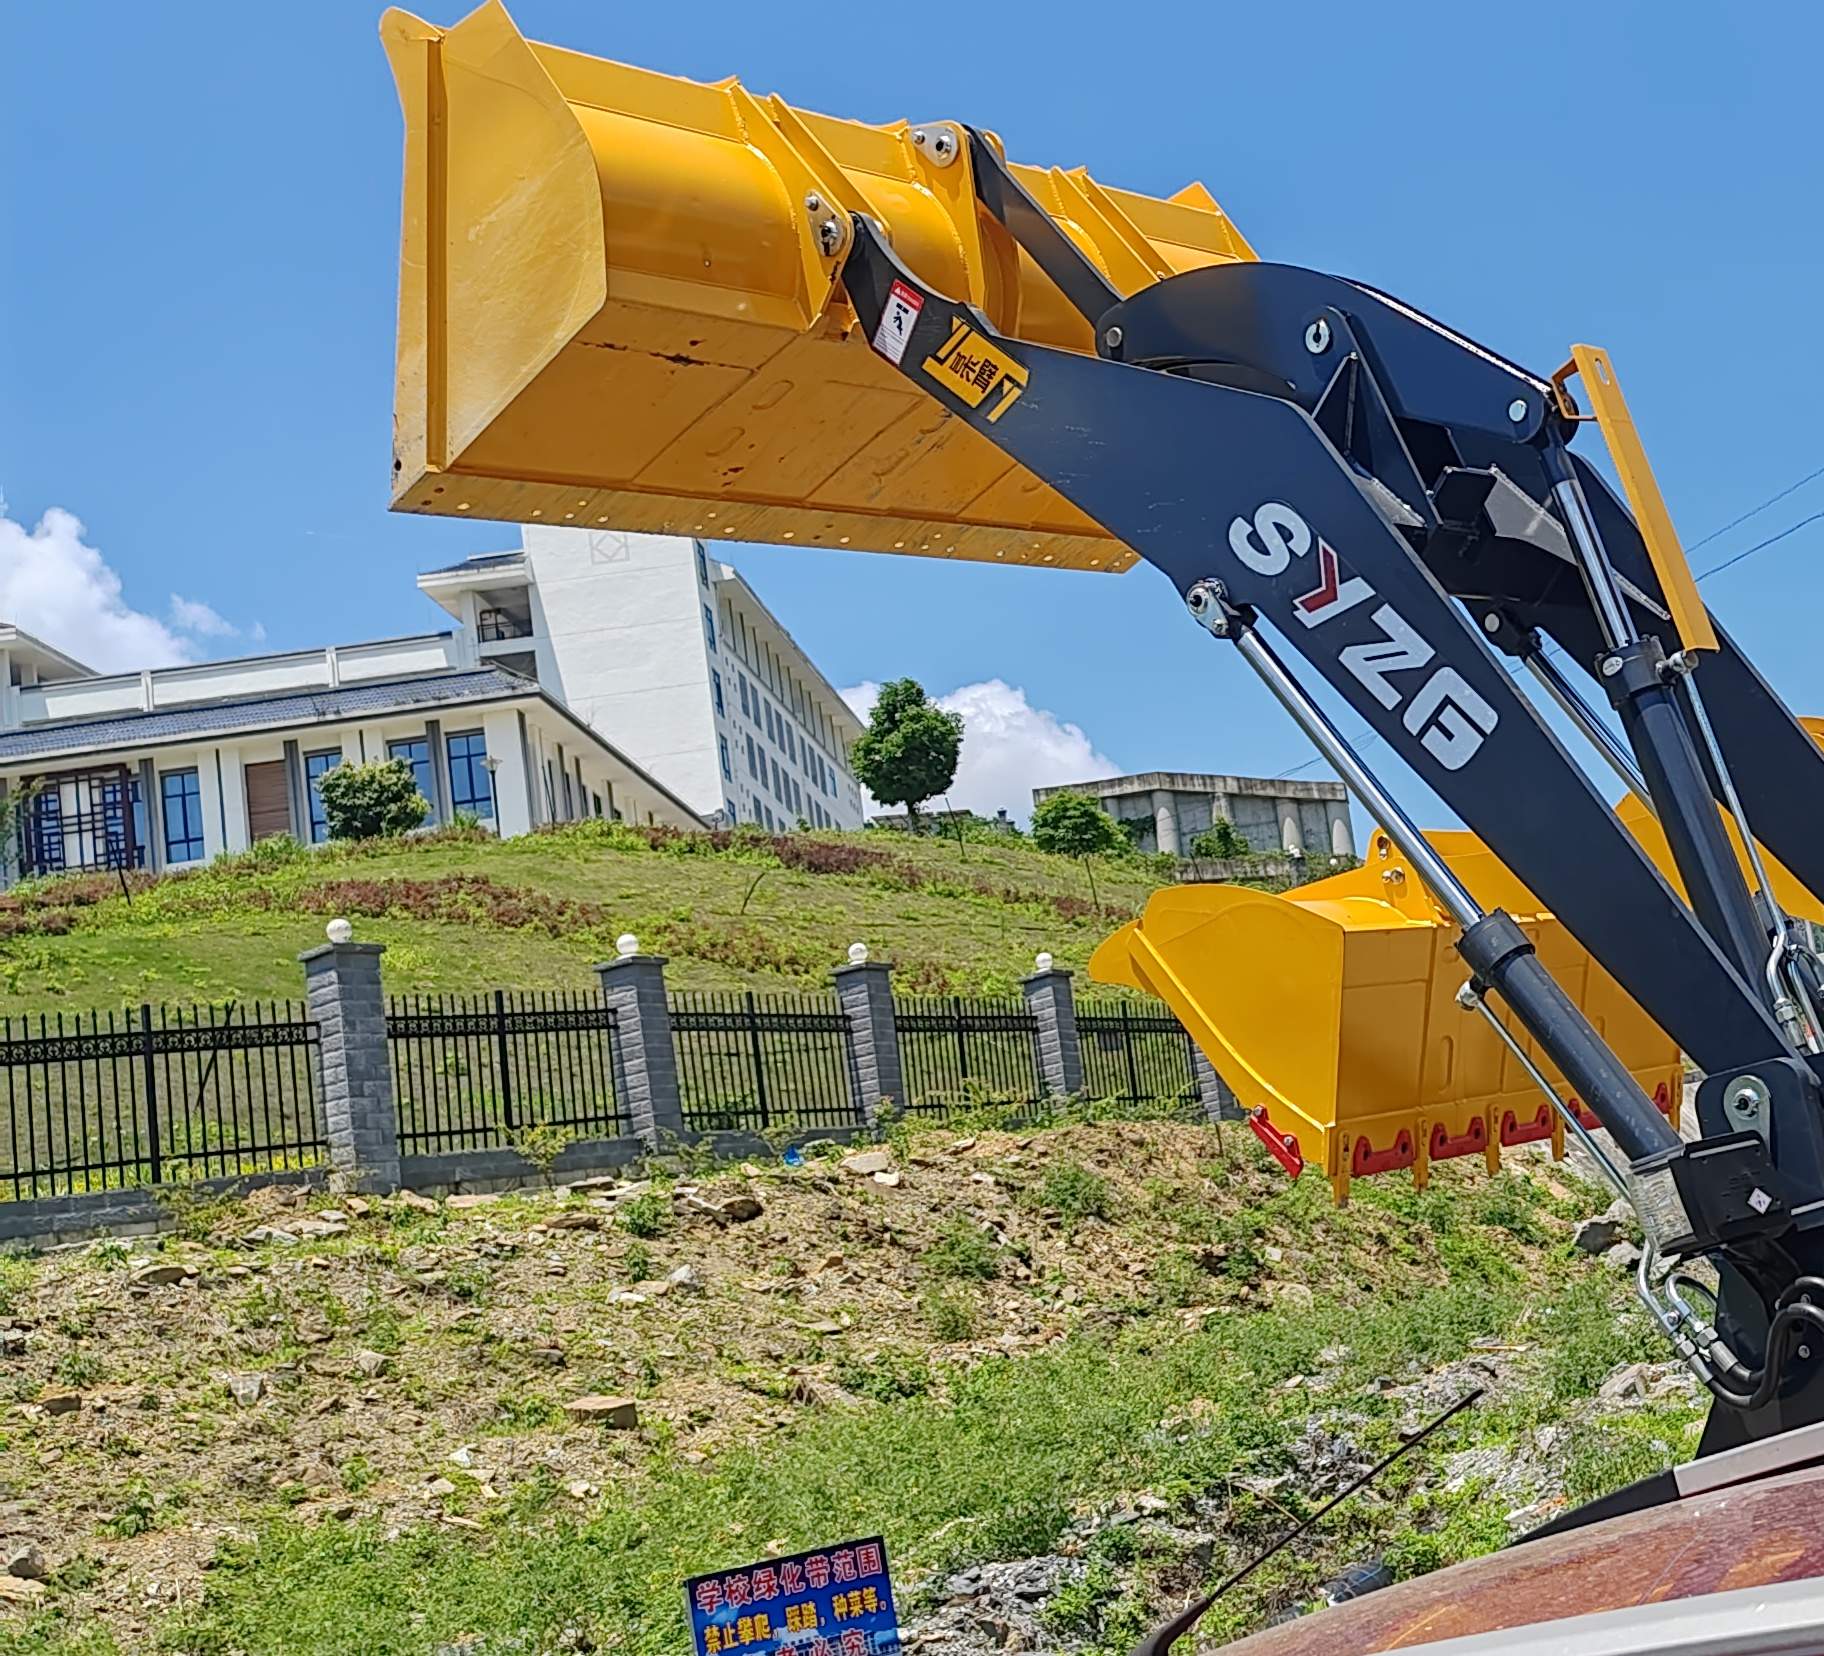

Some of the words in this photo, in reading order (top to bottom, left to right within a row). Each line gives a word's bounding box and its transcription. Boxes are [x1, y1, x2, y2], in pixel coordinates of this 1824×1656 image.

[1228, 502, 1499, 771] SYZG
[696, 1543, 883, 1616] 学校绿化带范围
